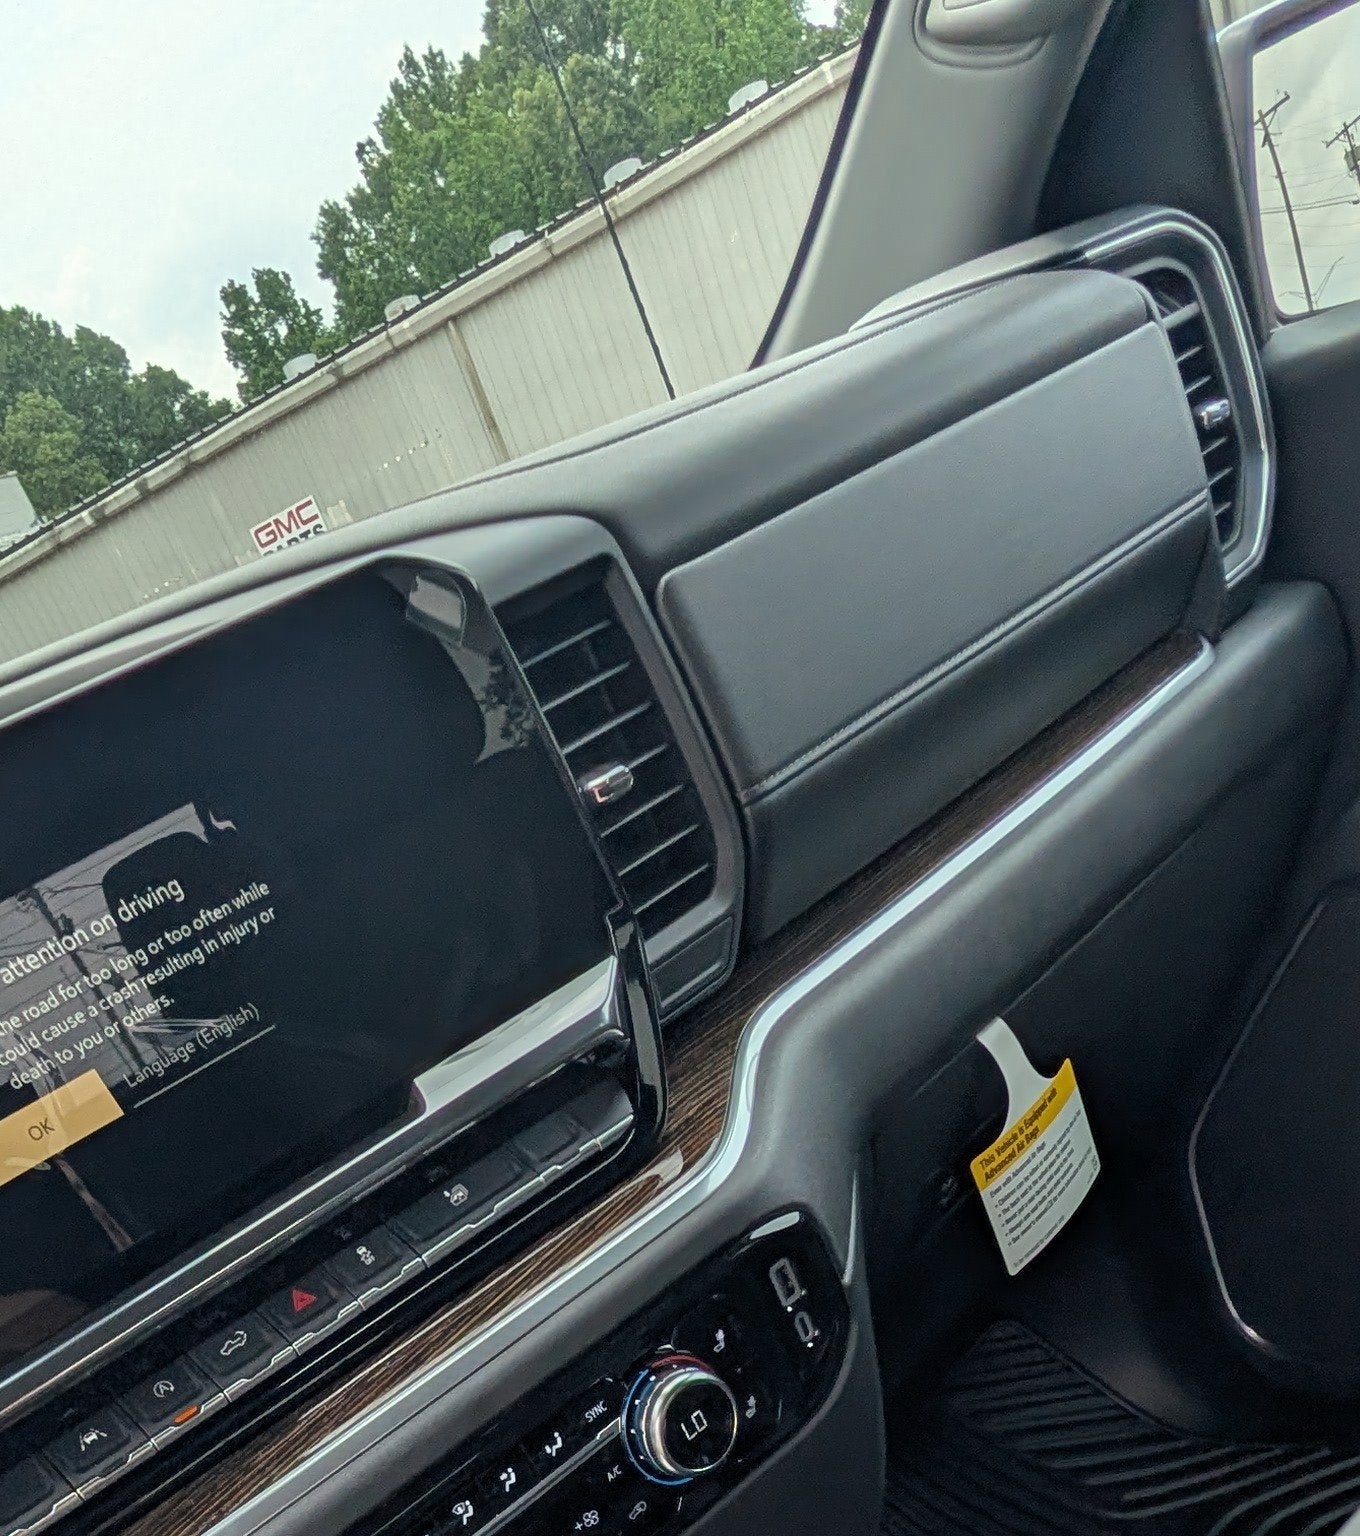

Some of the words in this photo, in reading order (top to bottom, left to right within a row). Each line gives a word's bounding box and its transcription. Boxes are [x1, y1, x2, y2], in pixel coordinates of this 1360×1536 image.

[254, 499, 320, 549] GMC
[0, 927, 90, 985] attention
[90, 914, 117, 938] on
[117, 879, 185, 923] driving
[22, 991, 60, 1022] road
[59, 980, 83, 1002] for
[82, 967, 112, 988] too
[110, 948, 149, 974] long
[147, 936, 165, 955] or
[164, 923, 192, 945] too
[192, 902, 233, 931] often
[232, 882, 270, 910] while
[41, 1010, 87, 1042] cause
[89, 1004, 99, 1018] a
[98, 977, 141, 1009] crash
[140, 946, 206, 989] resulting
[203, 937, 219, 955] in
[218, 915, 259, 947] injury
[260, 907, 276, 925] or
[10, 1058, 56, 1090] death
[55, 1048, 74, 1065] to
[73, 1032, 104, 1060] you
[103, 1022, 120, 1039] or
[122, 993, 176, 1029] others.
[123, 1041, 196, 1089] Language
[195, 1002, 261, 1050] (English)
[27, 1117, 55, 1142] OK
[584, 1401, 607, 1423] SYNC
[607, 1465, 622, 1483] A/C
